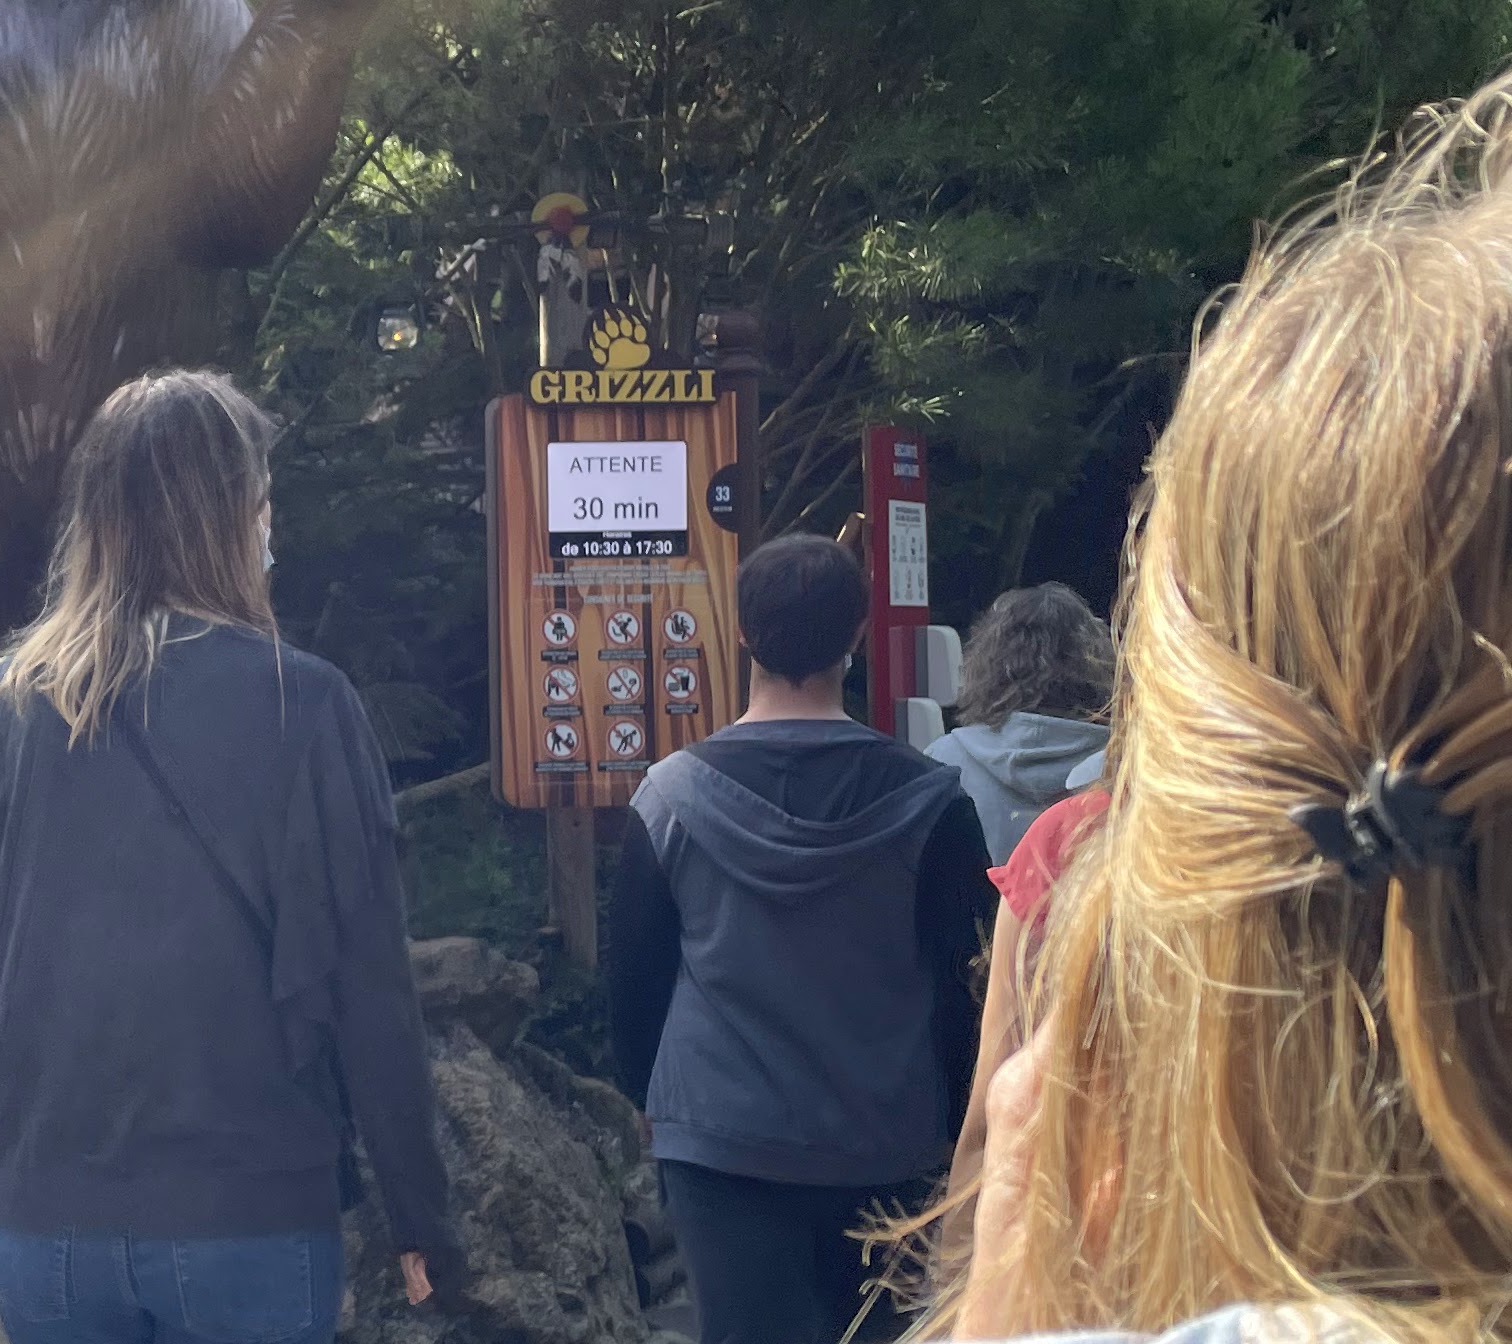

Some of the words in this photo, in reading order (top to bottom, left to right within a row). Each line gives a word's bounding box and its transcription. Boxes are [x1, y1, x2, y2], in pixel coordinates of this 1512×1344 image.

[529, 368, 717, 404] GRIZZLI
[569, 455, 663, 474] ATTENTE
[715, 485, 730, 502] 33
[573, 496, 604, 520] 30
[614, 496, 658, 519] min
[561, 542, 579, 556] de
[583, 540, 620, 556] 10:30
[623, 539, 632, 555] à
[635, 539, 673, 555] 17:30
